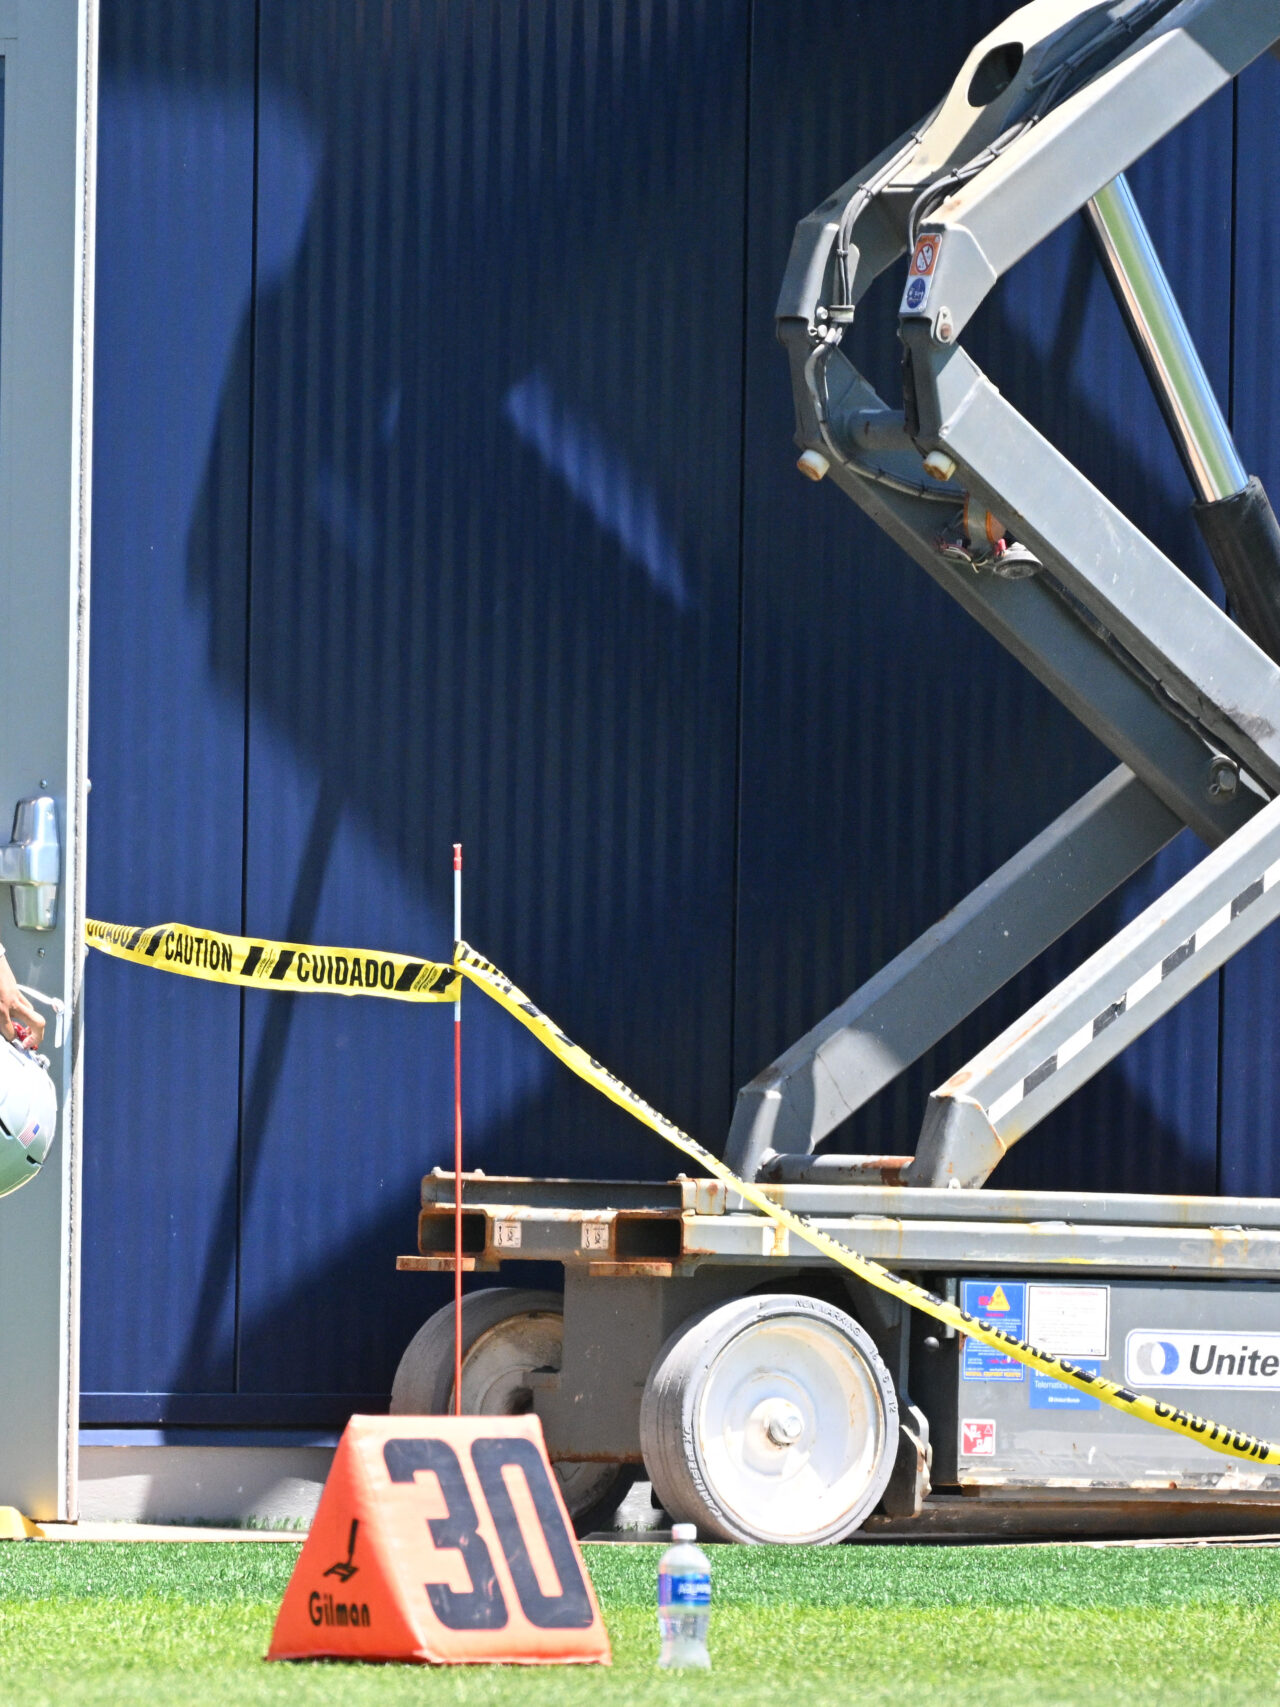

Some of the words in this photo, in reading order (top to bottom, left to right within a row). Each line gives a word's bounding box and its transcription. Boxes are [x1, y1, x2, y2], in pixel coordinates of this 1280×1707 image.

[165, 930, 233, 972] CAUTION
[296, 952, 395, 990] CUIDADO
[1189, 1344, 1280, 1377] Unite
[383, 1437, 594, 1630] 30
[308, 1590, 370, 1627] Gilman
